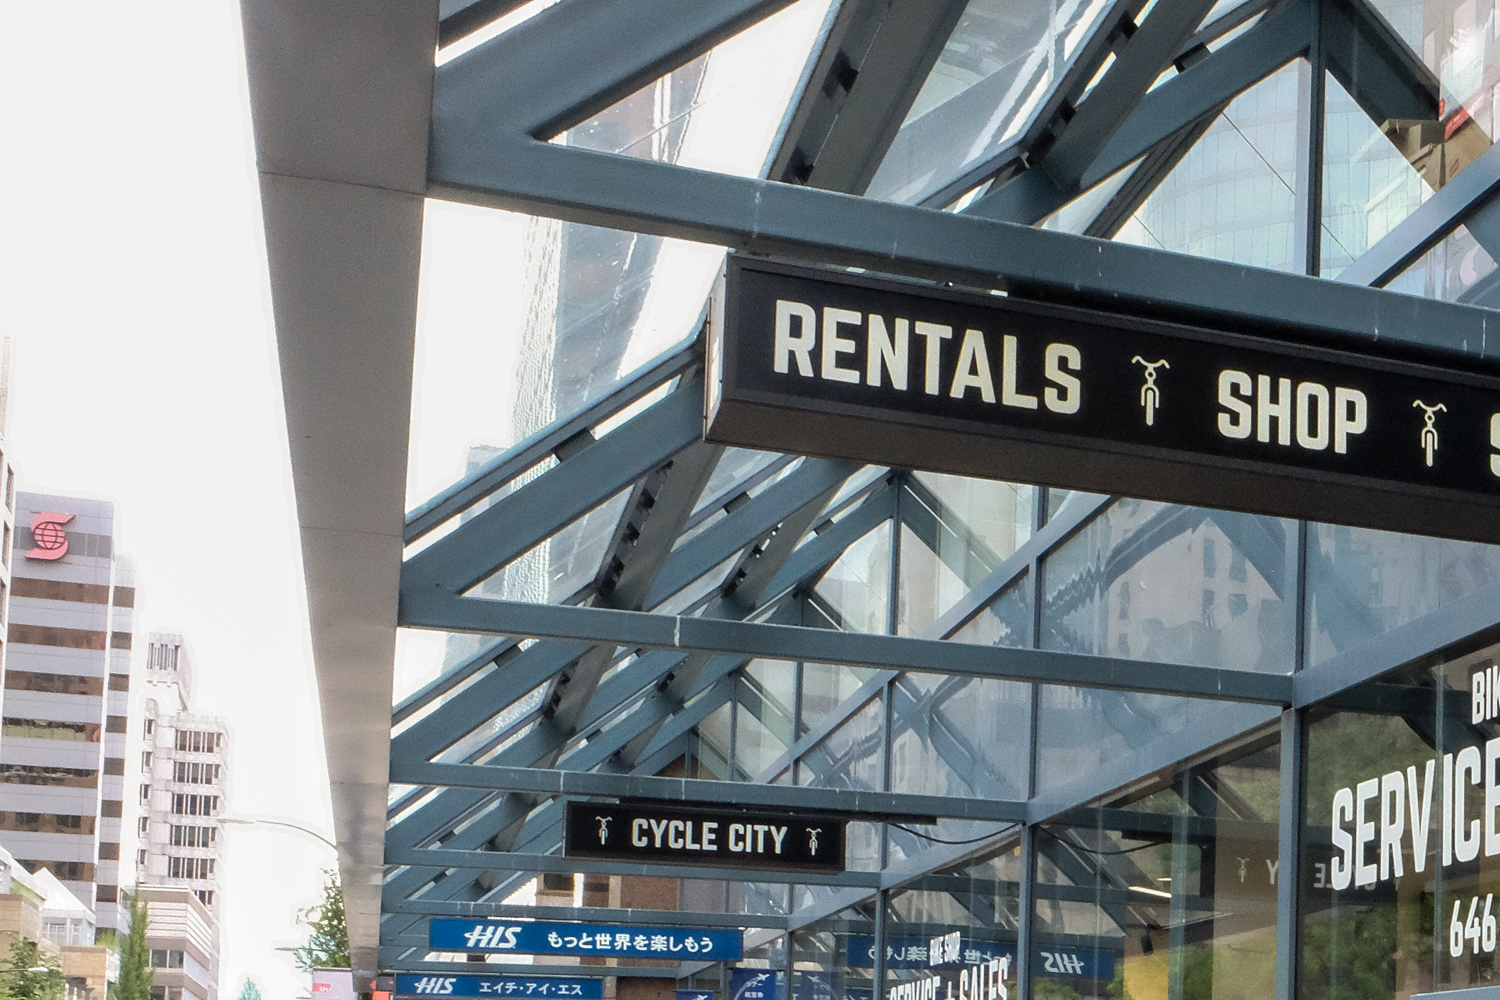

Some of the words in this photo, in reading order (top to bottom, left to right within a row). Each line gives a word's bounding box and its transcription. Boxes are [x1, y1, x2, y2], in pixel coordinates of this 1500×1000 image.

[773, 299, 1082, 415] RENTALS
[1216, 368, 1368, 455] SHOP
[631, 818, 719, 851] CYCLE
[728, 823, 788, 855] CITY
[547, 931, 714, 953] もっと世界を楽しもう
[1449, 891, 1496, 958] 646
[479, 980, 583, 997] エイチ・アイ・エス
